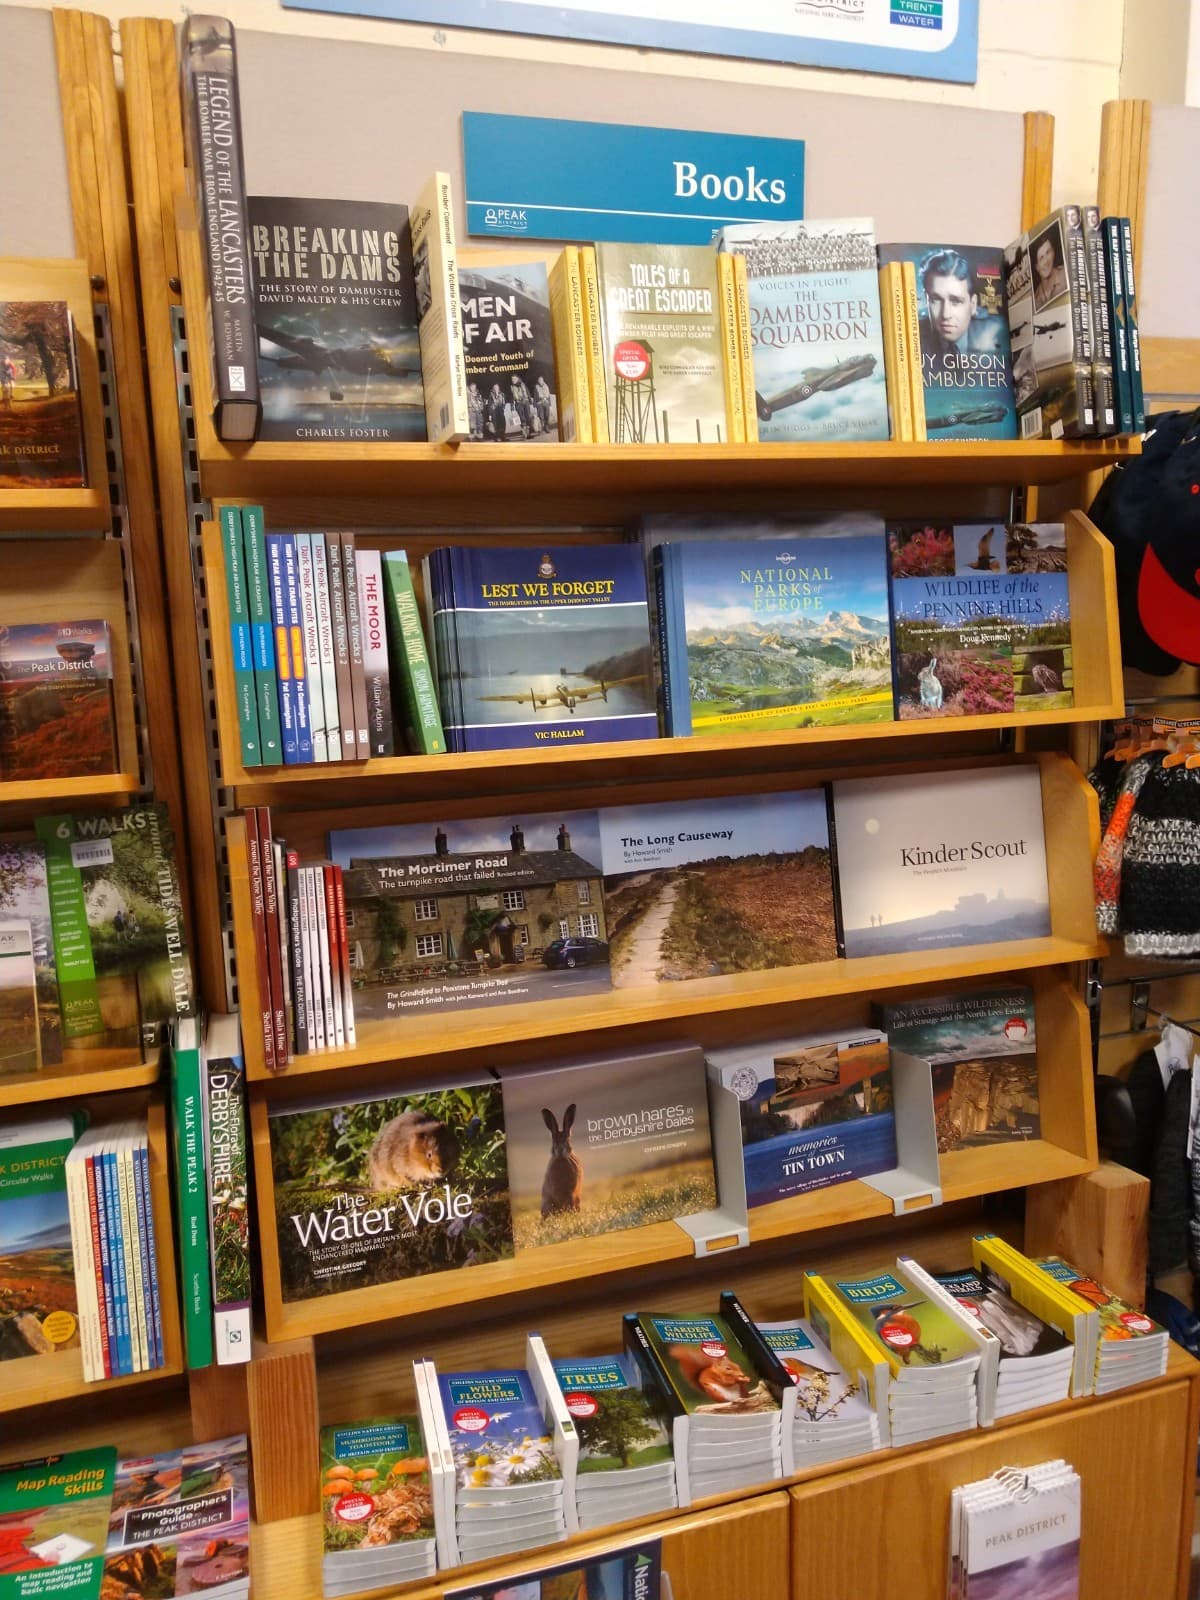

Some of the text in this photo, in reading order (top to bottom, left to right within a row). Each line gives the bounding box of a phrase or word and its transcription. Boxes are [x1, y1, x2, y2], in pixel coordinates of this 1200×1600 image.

[900, 1, 934, 13] TRENT
[899, 16, 935, 27] WATER
[209, 78, 246, 304] LEGEND OF THE LANCASTERS
[673, 161, 788, 205] Books
[442, 184, 453, 244] Bomber Command
[498, 210, 527, 221] PEAK
[253, 225, 400, 257] BREAKING
[254, 252, 402, 283] THE DAMS
[630, 263, 691, 288] TALES OF A
[260, 284, 402, 298] THE STORY OF DAMBUSTER
[759, 277, 850, 293] VOICES IN FLIGHT
[260, 295, 402, 308] DAVID MALTBY & HIS CREW
[571, 276, 580, 323] LANCASTER
[795, 290, 819, 303] THE
[459, 296, 517, 318] MEN
[751, 321, 869, 351] SQUADRON
[465, 348, 536, 365] Doomed Youth of
[943, 353, 1006, 370] GIBSON
[921, 370, 1009, 388] AMBUSTER
[296, 428, 390, 439] CHARLES FOSTER
[740, 567, 833, 584] NATIONAL
[481, 580, 615, 598] LEST WE FORGET
[754, 583, 822, 598] PARKS of
[924, 577, 1040, 598] WILDLIFE of the
[365, 573, 382, 650] THE MOOR
[753, 596, 824, 612] EUROPE
[923, 598, 1043, 618] PENNINE HILLS
[395, 590, 426, 666] WALKING HOME
[959, 631, 1012, 646] Doug Kennedy
[31, 659, 94, 674] Peak District
[373, 675, 385, 733] William Atkins
[535, 729, 586, 741] VIC HALLAM
[56, 812, 148, 839] 6 WALKS
[621, 829, 734, 848] The Long Causeway
[632, 846, 674, 858] Howard Smith
[900, 839, 1029, 868] Kinder Scout
[378, 856, 509, 880] The Mortimer Road
[378, 880, 397, 890] The
[397, 877, 433, 889] turnpike
[434, 874, 454, 885] road
[455, 872, 473, 883] that
[473, 870, 495, 881] failed
[387, 995, 445, 1011] By Howard Smith
[894, 997, 1026, 1020] AN ACCESSIBLE WILDERNESS
[262, 1011, 273, 1052] Sheila Hine
[587, 1112, 638, 1133] brown
[641, 1104, 685, 1123] hares
[210, 1074, 232, 1185] DERBYSHIRE
[589, 1133, 603, 1143] the
[604, 1121, 664, 1141] Derbyshire
[665, 1115, 696, 1130] Dales
[184, 1096, 197, 1194] WALK THE PEAK 2
[788, 1134, 840, 1157] memories
[10, 1155, 66, 1173] DISTRICT
[783, 1150, 847, 1178] TIN TOWN
[332, 1192, 369, 1212] The
[290, 1183, 474, 1249] Water Vole
[848, 1282, 897, 1298] BIRDS
[663, 1331, 716, 1340] WILDLIFE
[664, 1325, 709, 1333] GARDEN
[469, 1383, 502, 1394] WILD
[562, 1371, 619, 1386] TREES
[459, 1389, 515, 1401] FLOWERS
[349, 1440, 396, 1452] TOADSTOOLS
[16, 1468, 105, 1492] Map Reading
[64, 1480, 104, 1497] Skills
[141, 1493, 228, 1521] Photographer's
[133, 1511, 225, 1541] THE PEAK DISTRICT
[159, 1511, 194, 1527] Guide
[985, 1513, 1068, 1550] PEAK DISTRICT
[15, 1562, 94, 1583] An introduction to
[21, 1567, 93, 1590] map reading and
[21, 1577, 92, 1596] basic navigation
